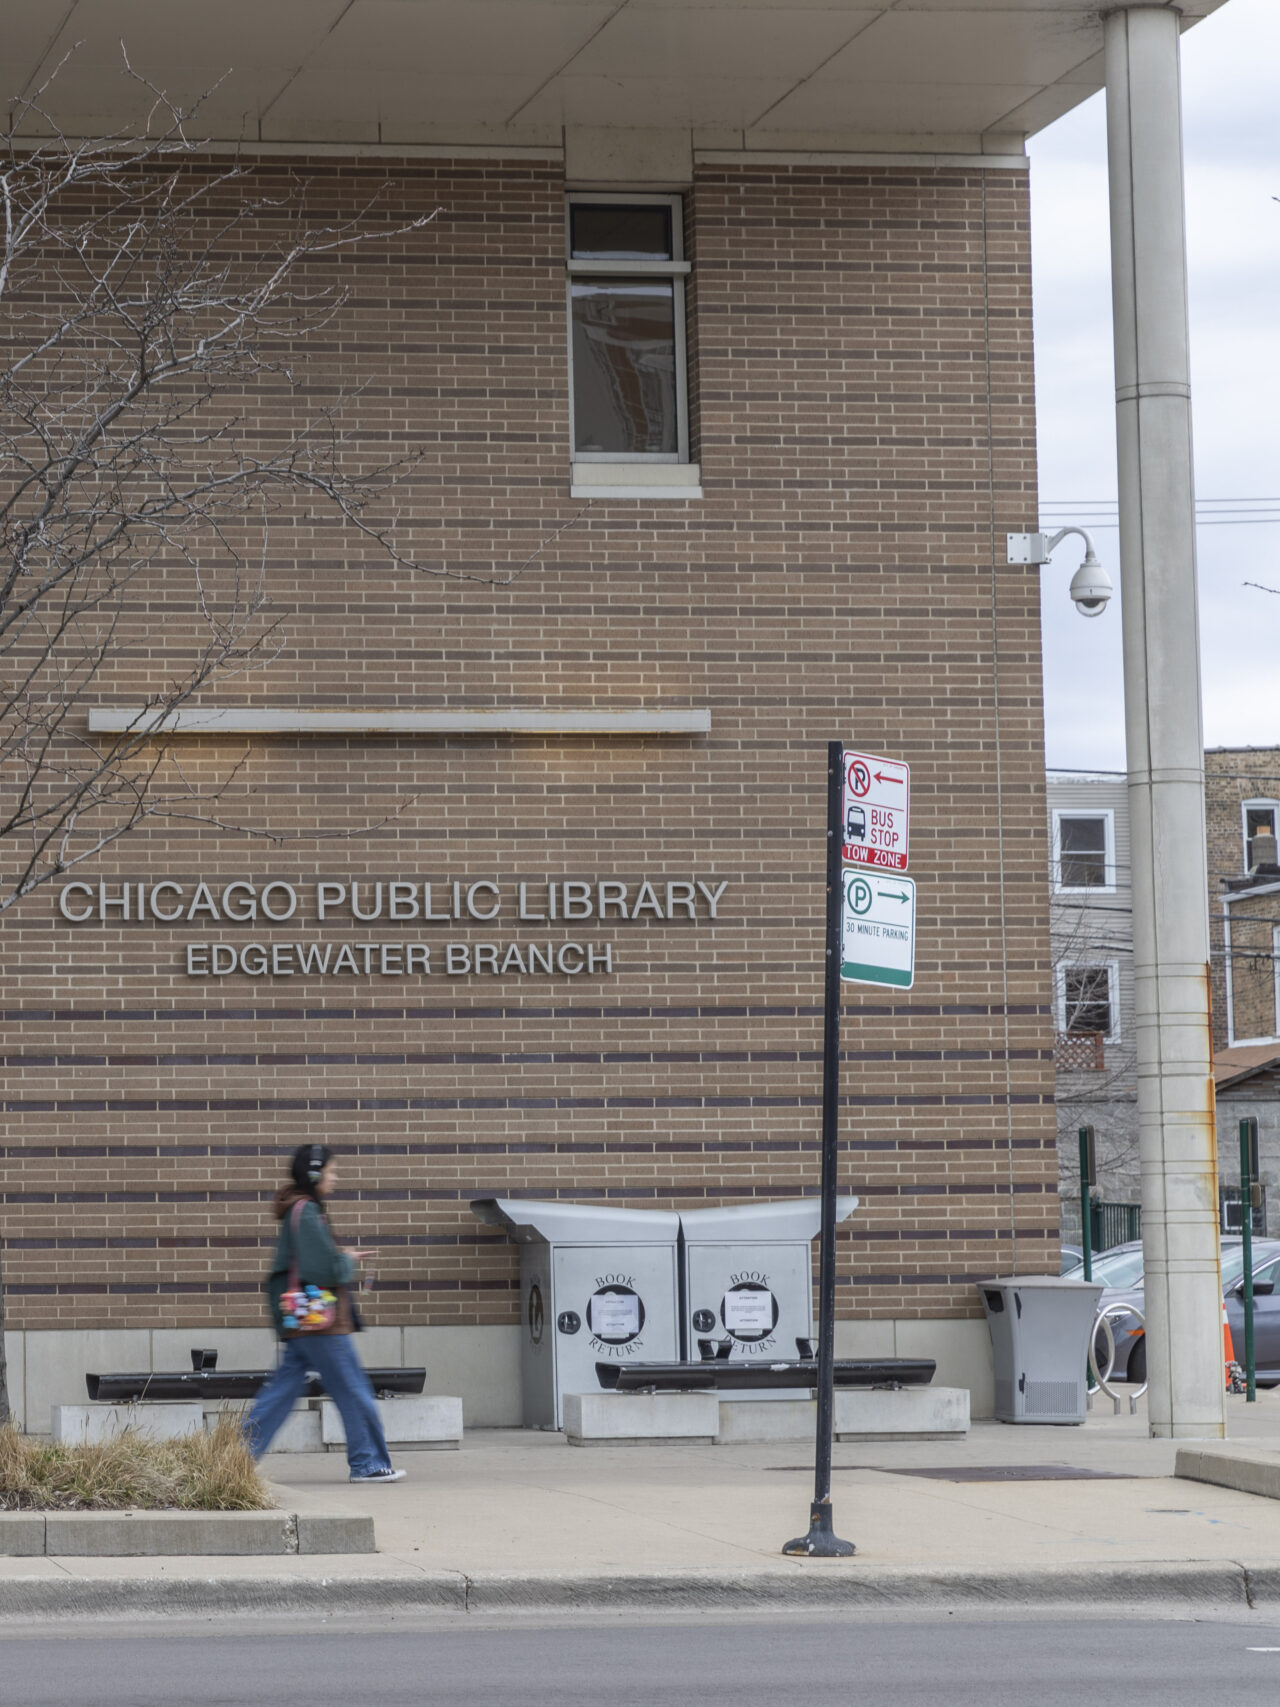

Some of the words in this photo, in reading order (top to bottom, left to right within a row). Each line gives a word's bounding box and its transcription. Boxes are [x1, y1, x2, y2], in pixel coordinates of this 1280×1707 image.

[871, 809, 894, 829] BUS
[870, 828, 899, 848] STOP
[846, 844, 869, 862] TOW
[873, 849, 902, 868] ZONE
[58, 881, 299, 922] CHICAGO
[317, 881, 502, 922] PUBLIC
[518, 880, 729, 921] LIBRARY
[846, 921, 855, 933] 30
[857, 923, 881, 937] MINUTE
[882, 927, 909, 942] PARKING
[185, 943, 432, 976] EDGEWATER
[446, 942, 614, 974] BRANCH
[595, 1273, 636, 1288] BOOK
[730, 1271, 771, 1286] BOOK
[589, 1337, 644, 1357] RETURN
[723, 1334, 777, 1354] RETURN
